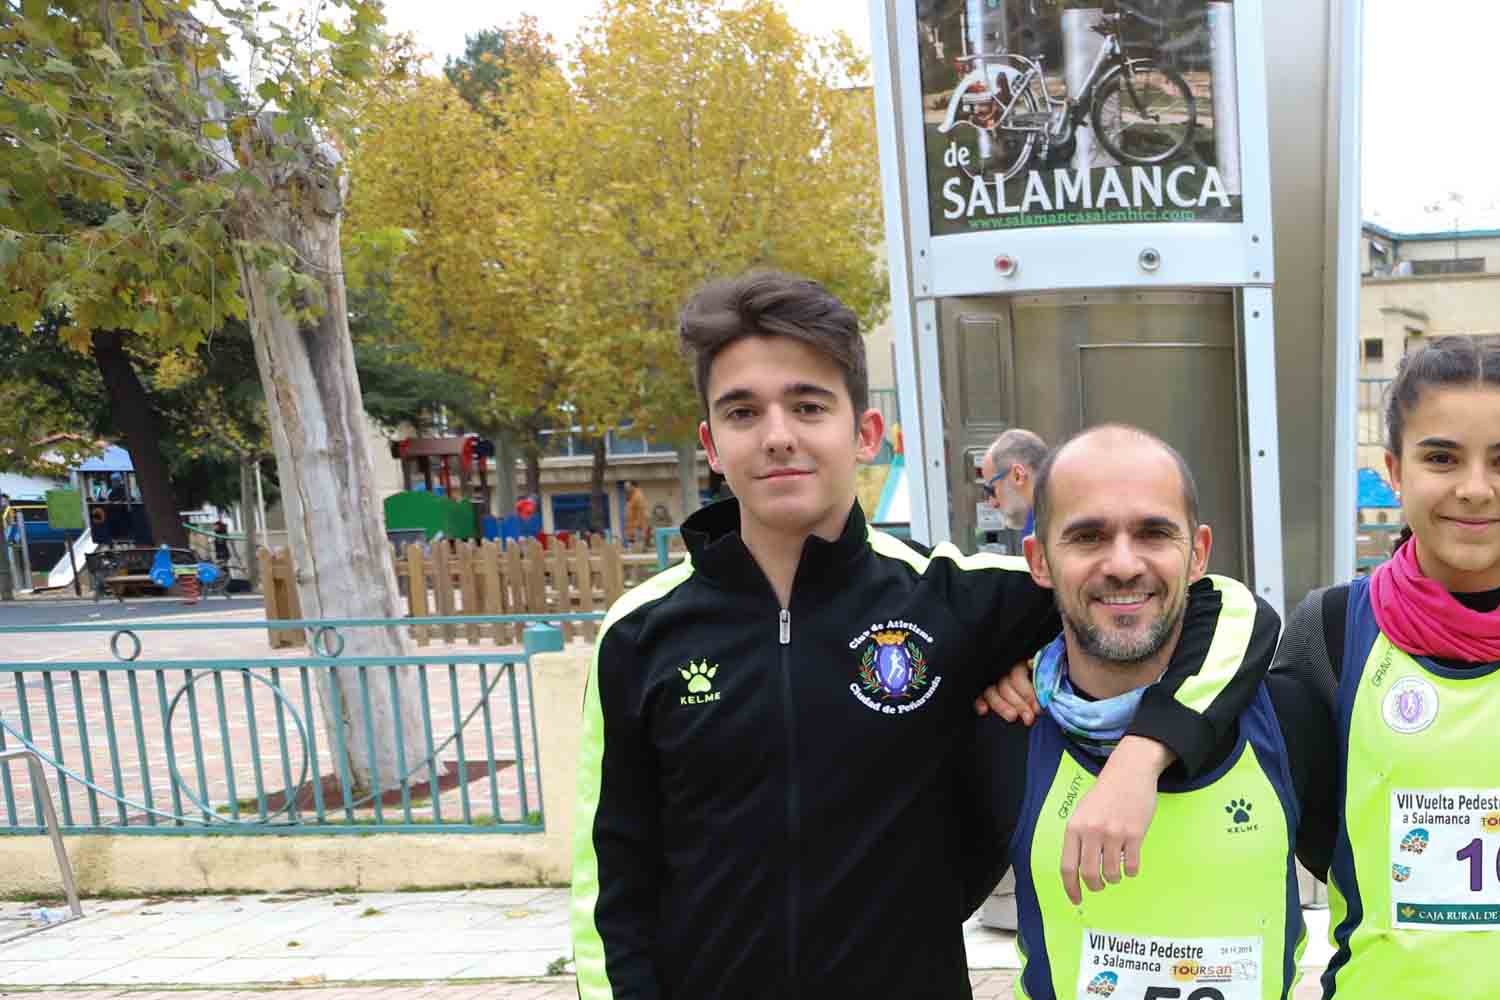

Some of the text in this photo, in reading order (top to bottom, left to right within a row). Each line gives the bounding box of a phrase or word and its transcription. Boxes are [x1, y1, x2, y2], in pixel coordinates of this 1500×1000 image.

[943, 142, 971, 168] de
[942, 166, 1232, 219] SALAMANCA
[849, 619, 934, 649] Club de Atletismo
[680, 691, 721, 705] KELME
[849, 676, 942, 714] Ciudad de Peñaranda
[1397, 794, 1413, 809] VII
[1416, 795, 1454, 809] Vuelta
[1403, 812, 1470, 825] a Salamanca
[1419, 911, 1443, 921] CAJA
[1446, 911, 1481, 921] RURAL
[1484, 911, 1498, 921] DE
[1089, 933, 1203, 959] VII Vuelta Pedestre
[1093, 954, 1161, 972] a Salamanca
